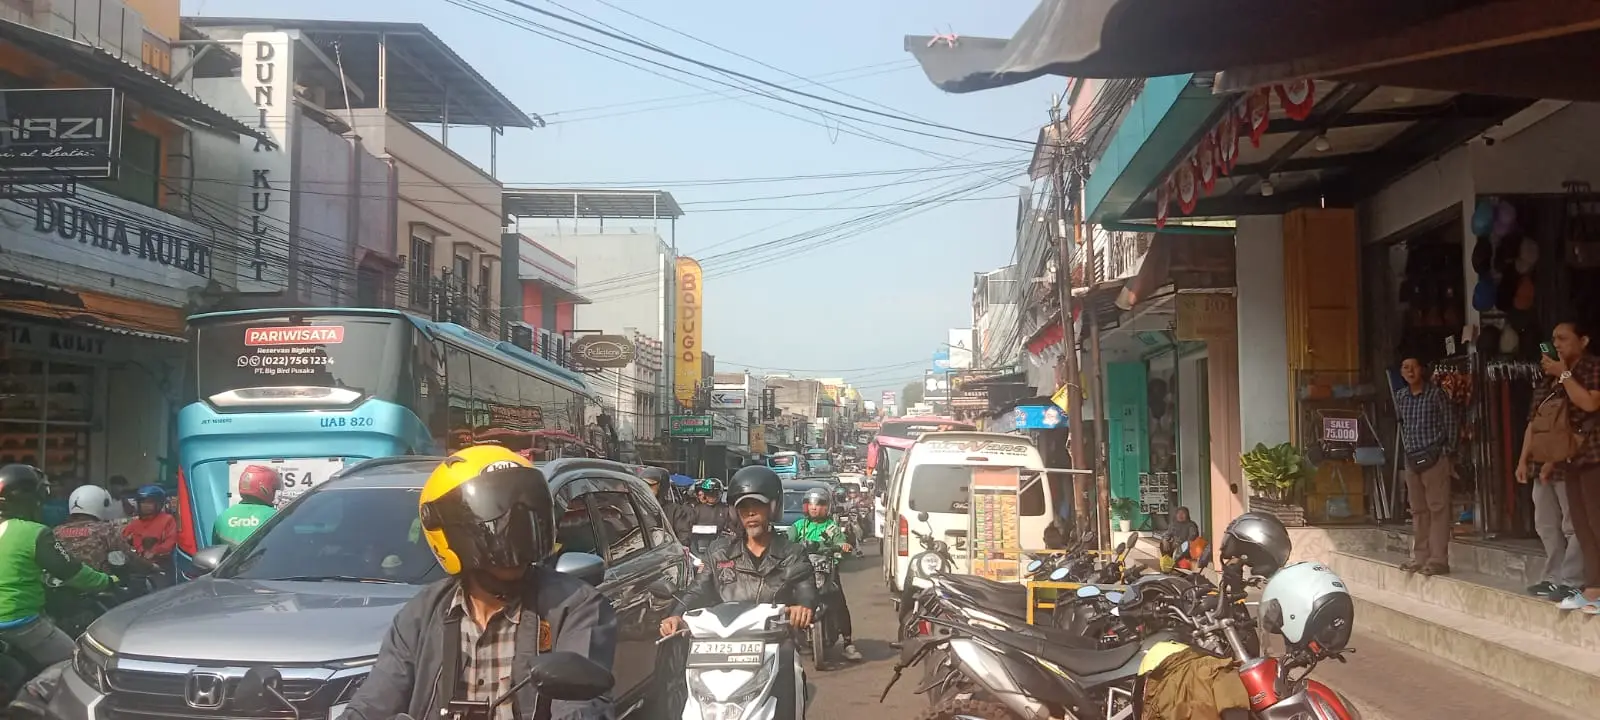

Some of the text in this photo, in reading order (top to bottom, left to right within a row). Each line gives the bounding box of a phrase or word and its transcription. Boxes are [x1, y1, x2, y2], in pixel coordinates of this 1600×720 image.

[251, 169, 272, 281] KULIT
[34, 197, 210, 275] DUNIA KULIT
[250, 329, 338, 342] PARIWISATA
[262, 356, 288, 366] (022)
[320, 417, 373, 427] UAB 820
[1330, 420, 1350, 428] SALE
[300, 472, 313, 487] 4
[228, 516, 260, 527] Grab
